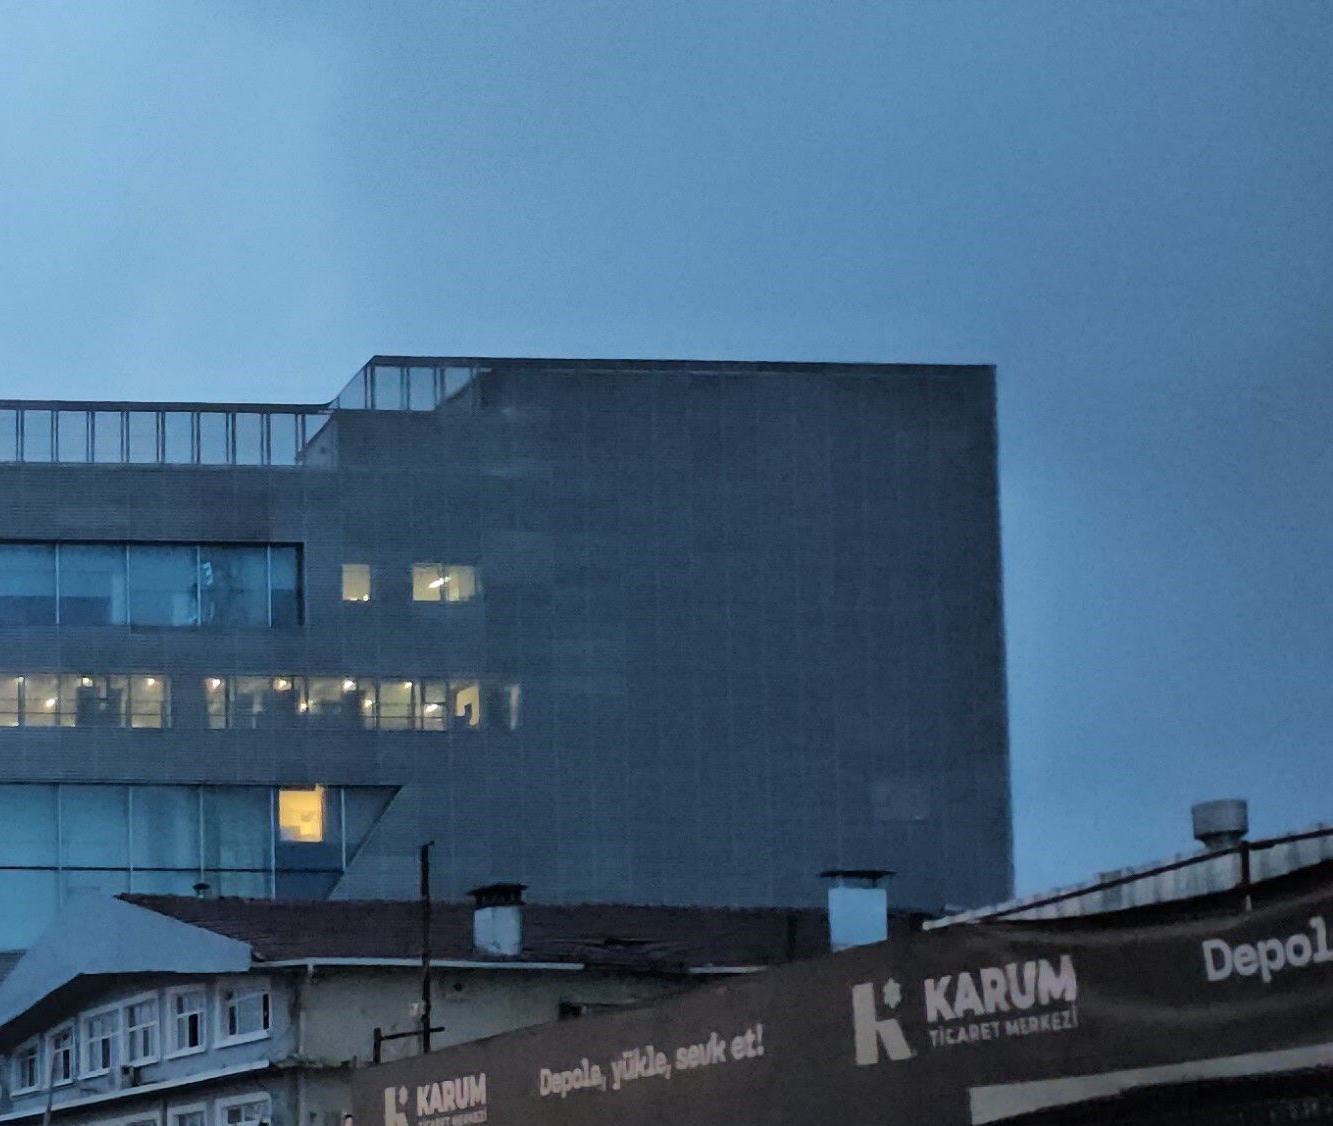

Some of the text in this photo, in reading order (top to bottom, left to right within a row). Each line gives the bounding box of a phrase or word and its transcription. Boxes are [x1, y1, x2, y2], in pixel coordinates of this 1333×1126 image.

[924, 954, 1077, 1023] KARUM
[930, 1003, 1078, 1048] TİCARET MERKEZİ
[610, 1046, 672, 1091] yükle,
[676, 1033, 725, 1071] sevk
[729, 1023, 765, 1060] et!
[417, 1073, 486, 1117] KARUM
